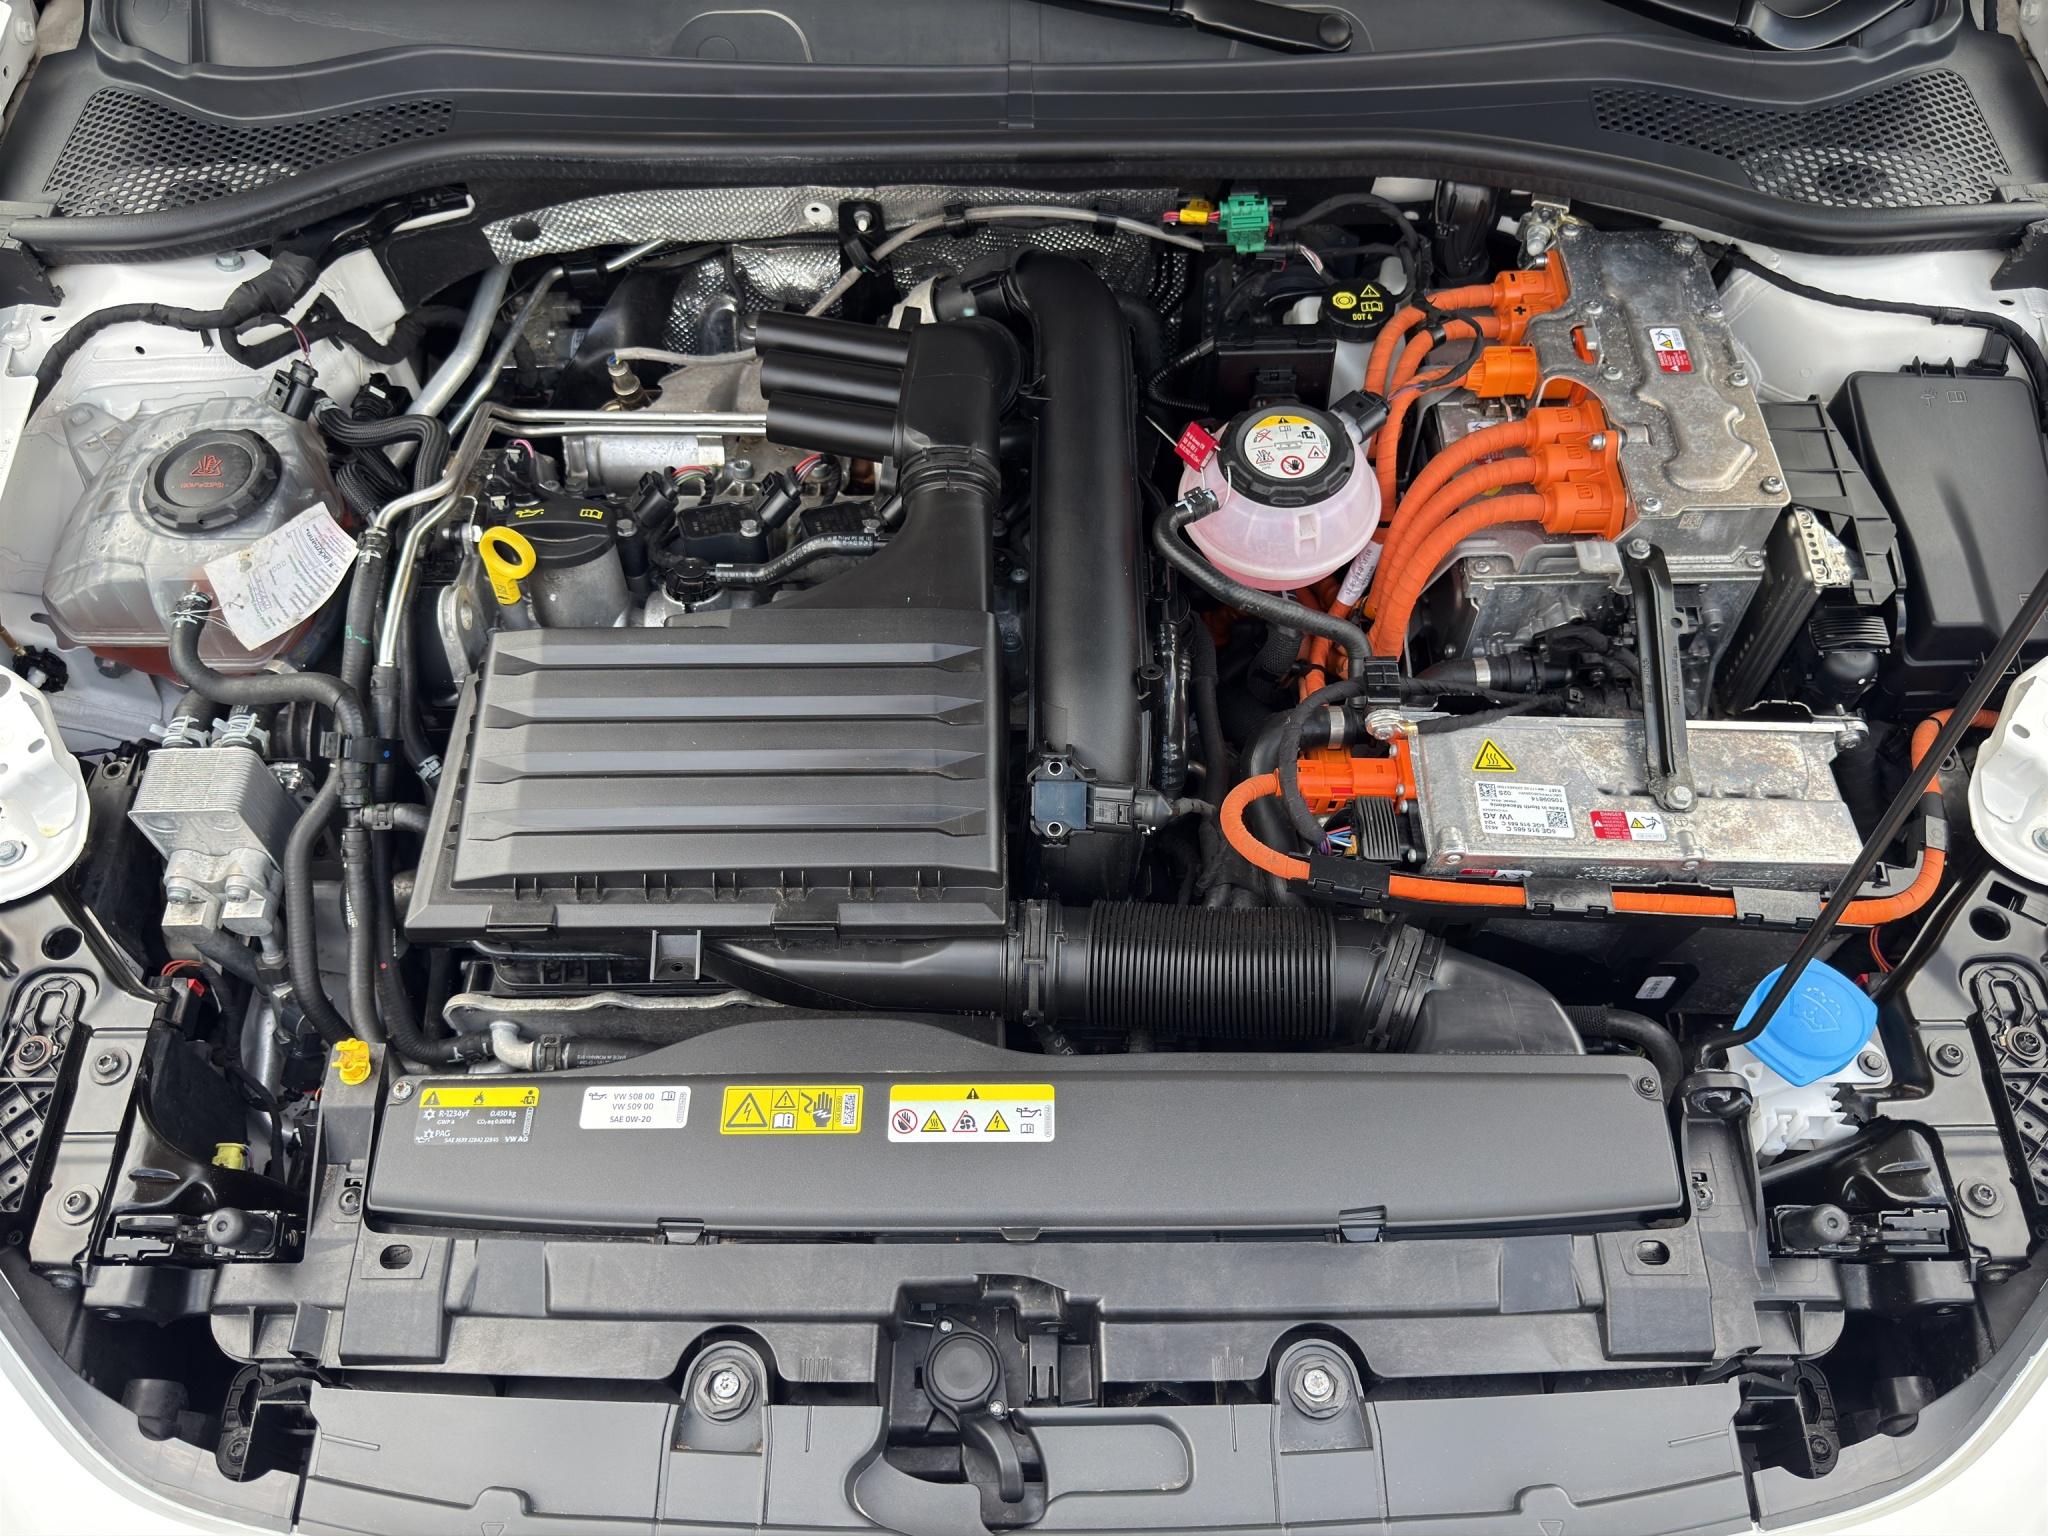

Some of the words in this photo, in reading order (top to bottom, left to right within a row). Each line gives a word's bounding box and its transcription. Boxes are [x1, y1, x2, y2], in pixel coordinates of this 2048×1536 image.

[644, 1092, 655, 1100] 00
[438, 1109, 471, 1119] R-1234yf
[508, 1110, 517, 1118] kg
[609, 1115, 624, 1123] SAE
[625, 1115, 652, 1123] 0W-20
